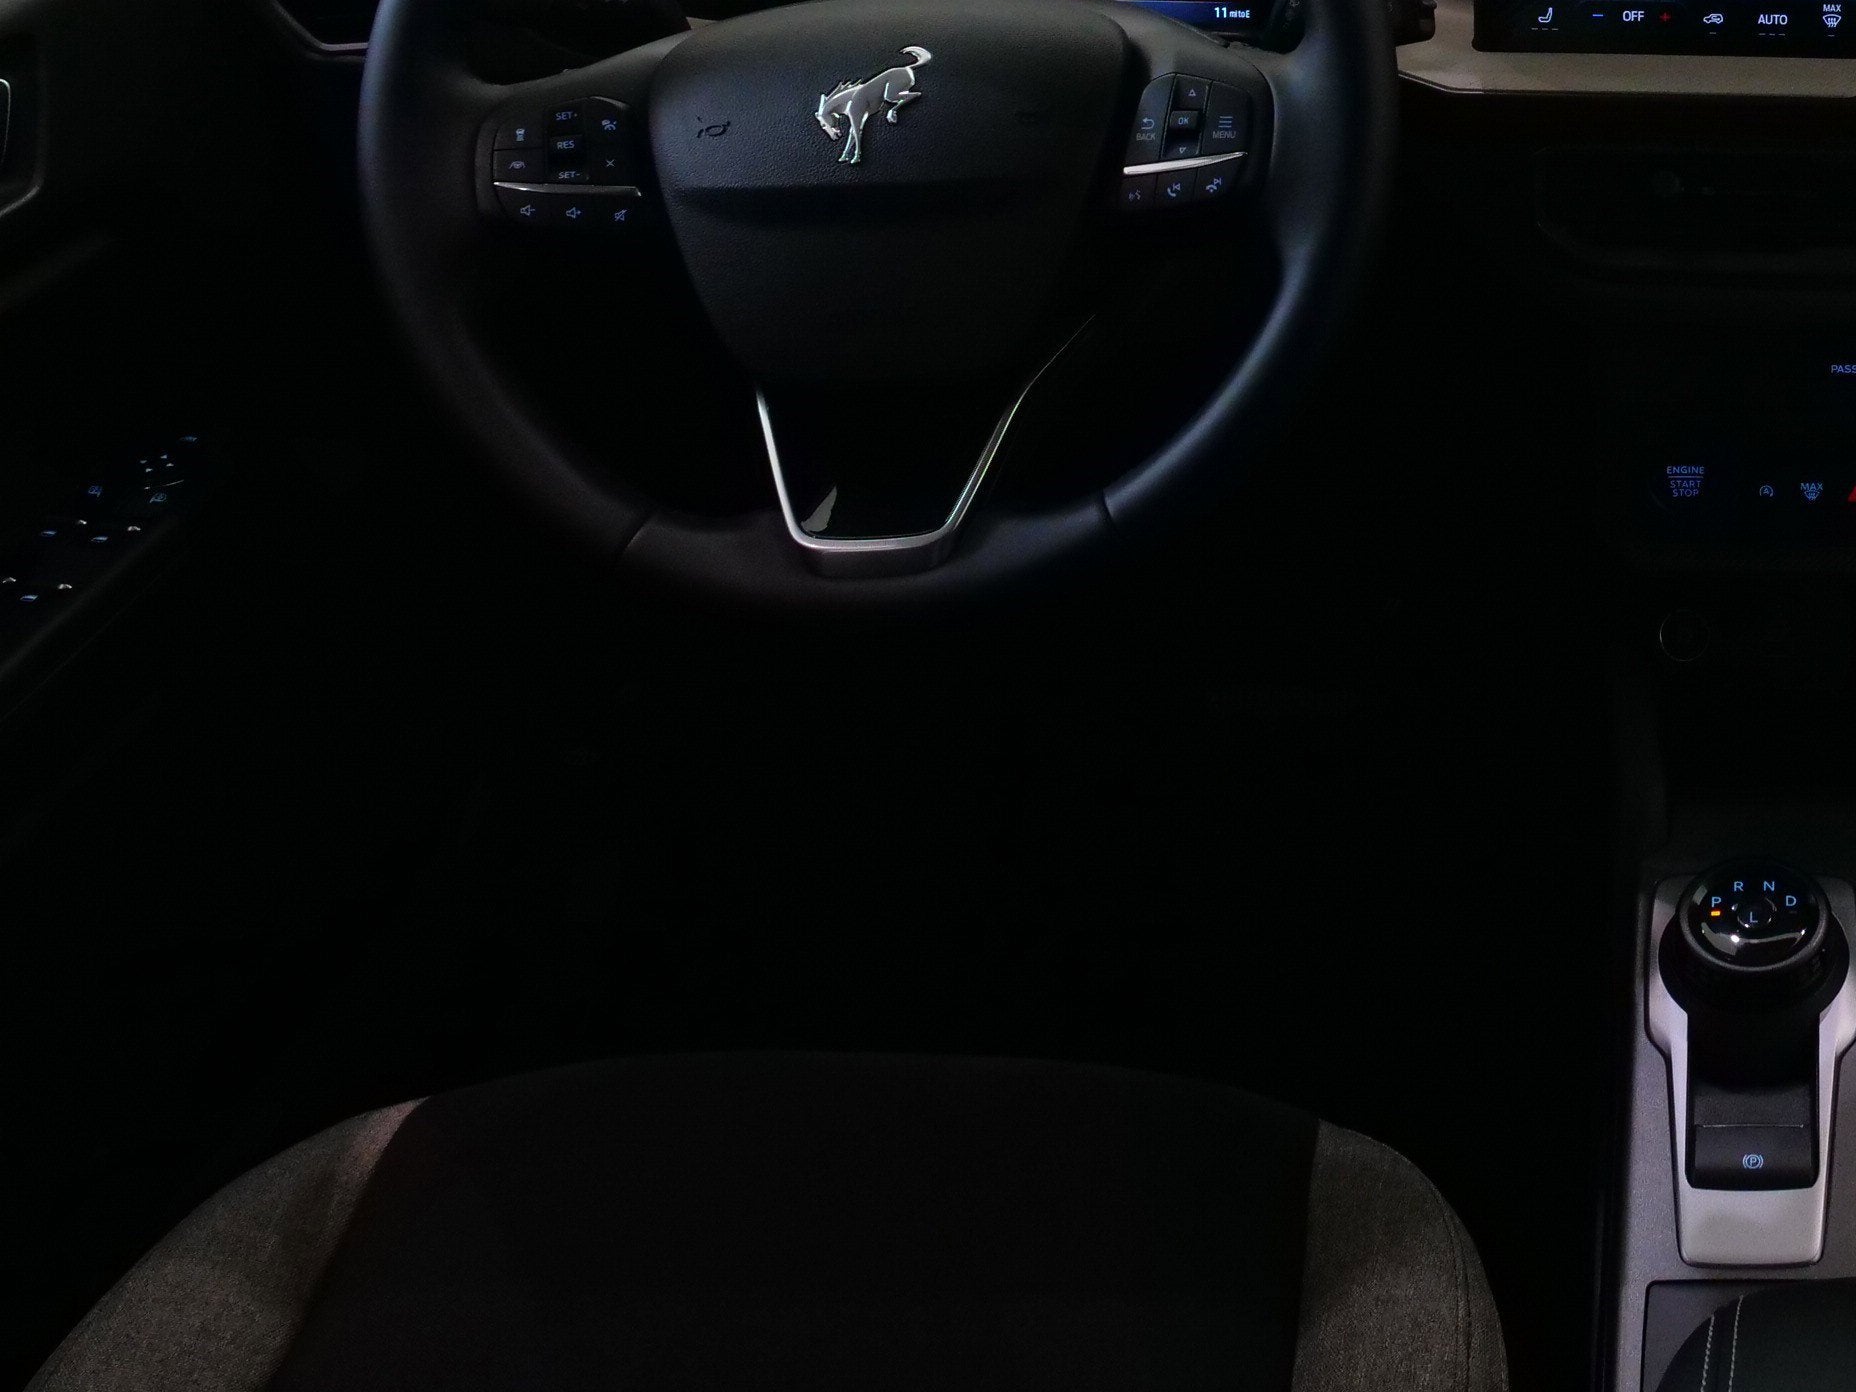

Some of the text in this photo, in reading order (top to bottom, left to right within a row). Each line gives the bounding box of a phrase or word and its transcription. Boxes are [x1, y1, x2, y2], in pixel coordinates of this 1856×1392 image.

[1214, 7, 1228, 18] 11
[1822, 3, 1841, 12] MAX
[1622, 11, 1645, 22] OFF
[1757, 14, 1788, 26] AUTO
[1178, 117, 1189, 125] OK
[1136, 133, 1155, 141] BACK
[1213, 131, 1236, 139] MENU
[557, 140, 575, 150] RES
[1666, 465, 1705, 475] ENGINE
[1669, 479, 1702, 489] START
[1800, 482, 1824, 492] MAX
[1671, 488, 1700, 498] STOP
[1711, 881, 1796, 907] P R N D
[1750, 912, 1758, 923] L
